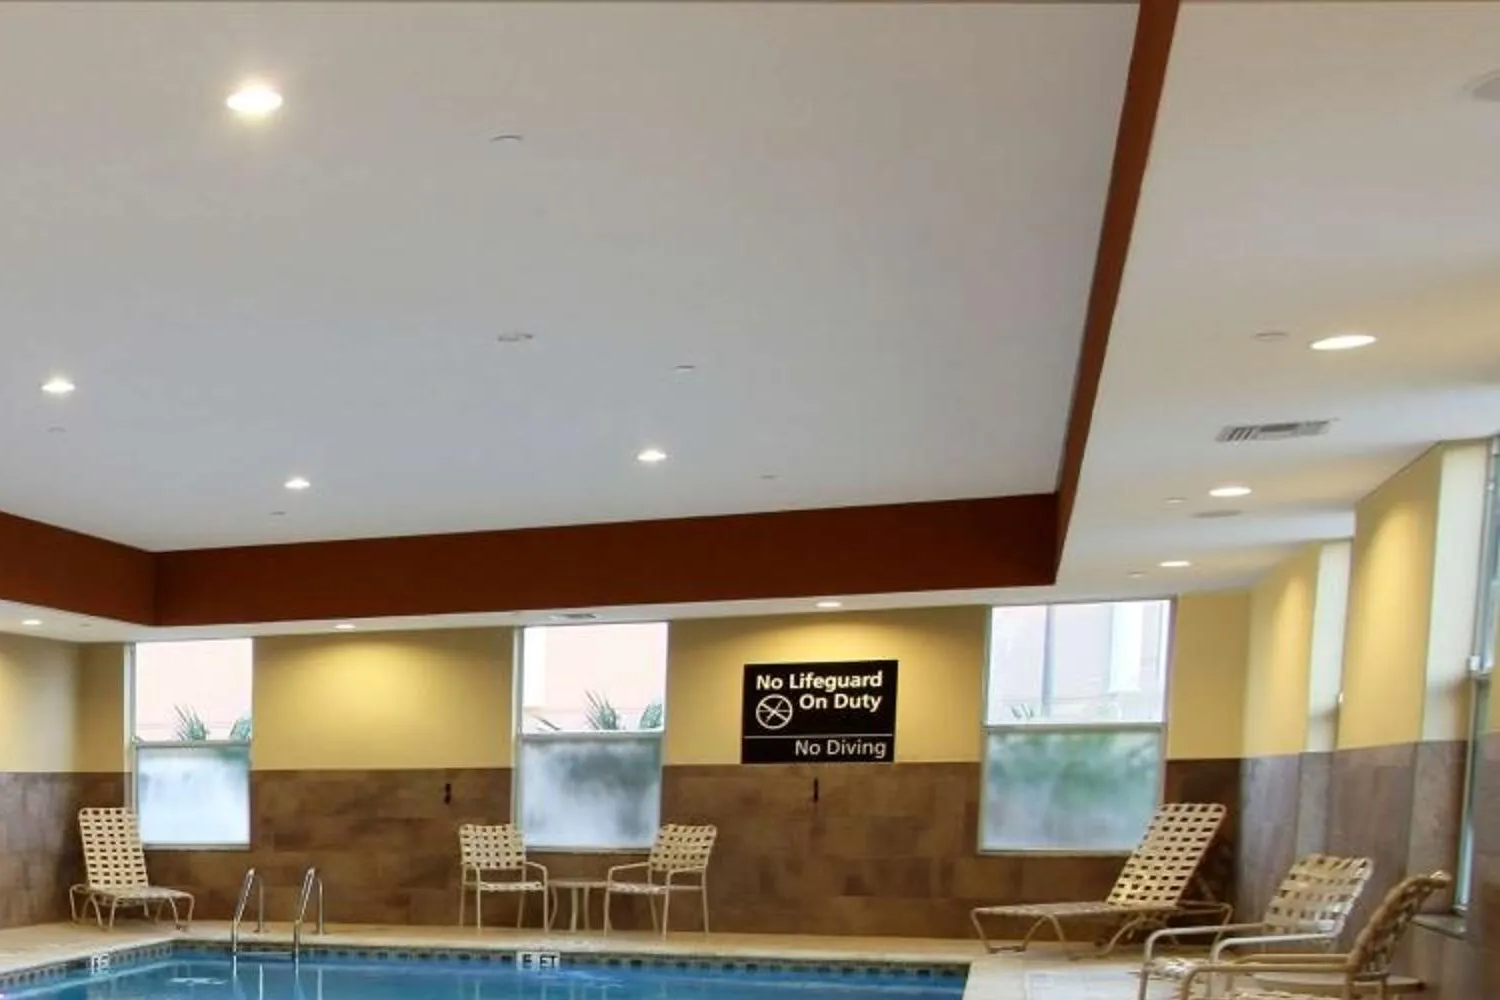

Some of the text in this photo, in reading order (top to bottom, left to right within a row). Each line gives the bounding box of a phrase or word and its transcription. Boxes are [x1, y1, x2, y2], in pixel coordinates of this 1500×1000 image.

[756, 670, 883, 692] No Lifeguard
[800, 693, 882, 712] On Duty
[795, 739, 886, 758] No Diving
